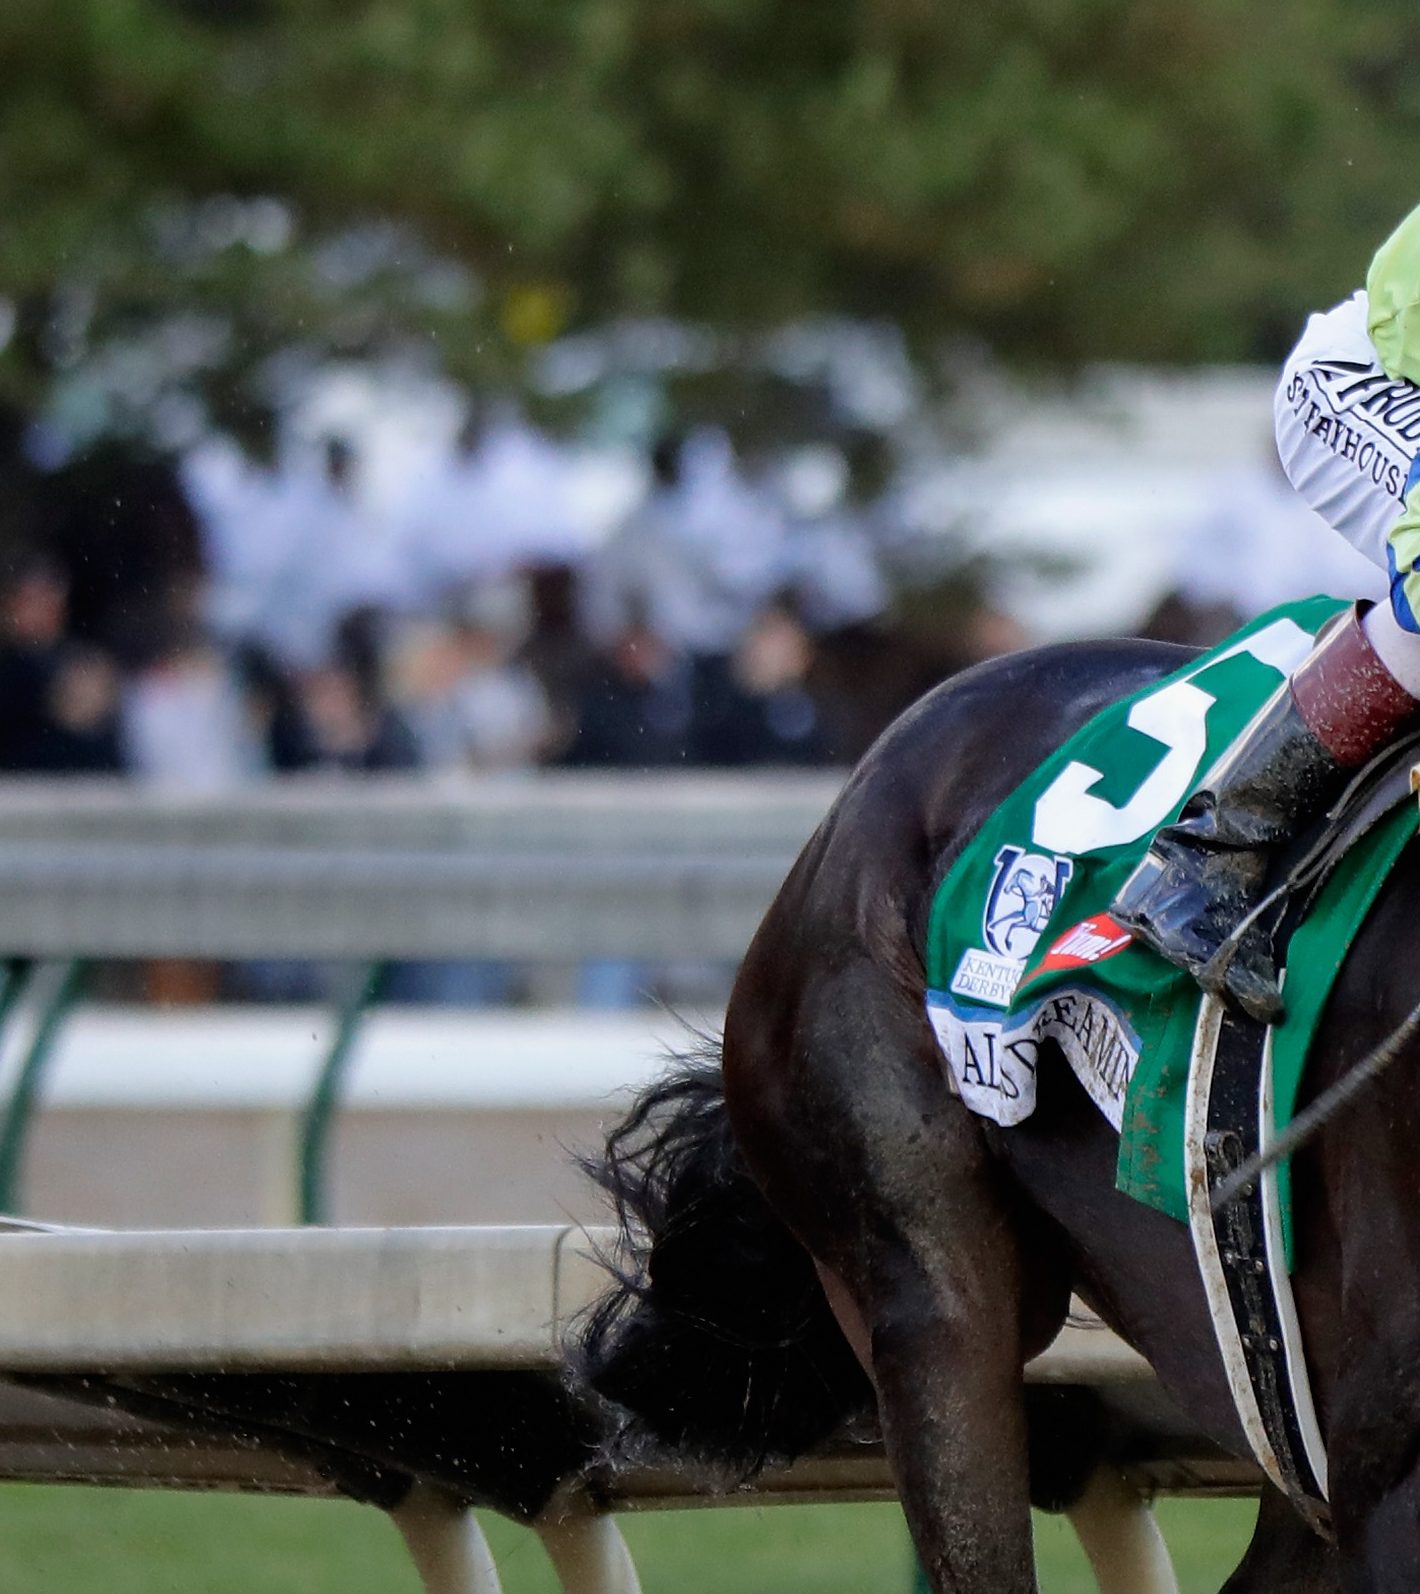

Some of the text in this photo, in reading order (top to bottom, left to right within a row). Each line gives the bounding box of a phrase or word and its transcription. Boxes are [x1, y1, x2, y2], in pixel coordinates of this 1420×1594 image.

[1032, 617, 1316, 855] 5
[963, 957, 1023, 985] KENTUC
[956, 974, 1012, 998] DERBY
